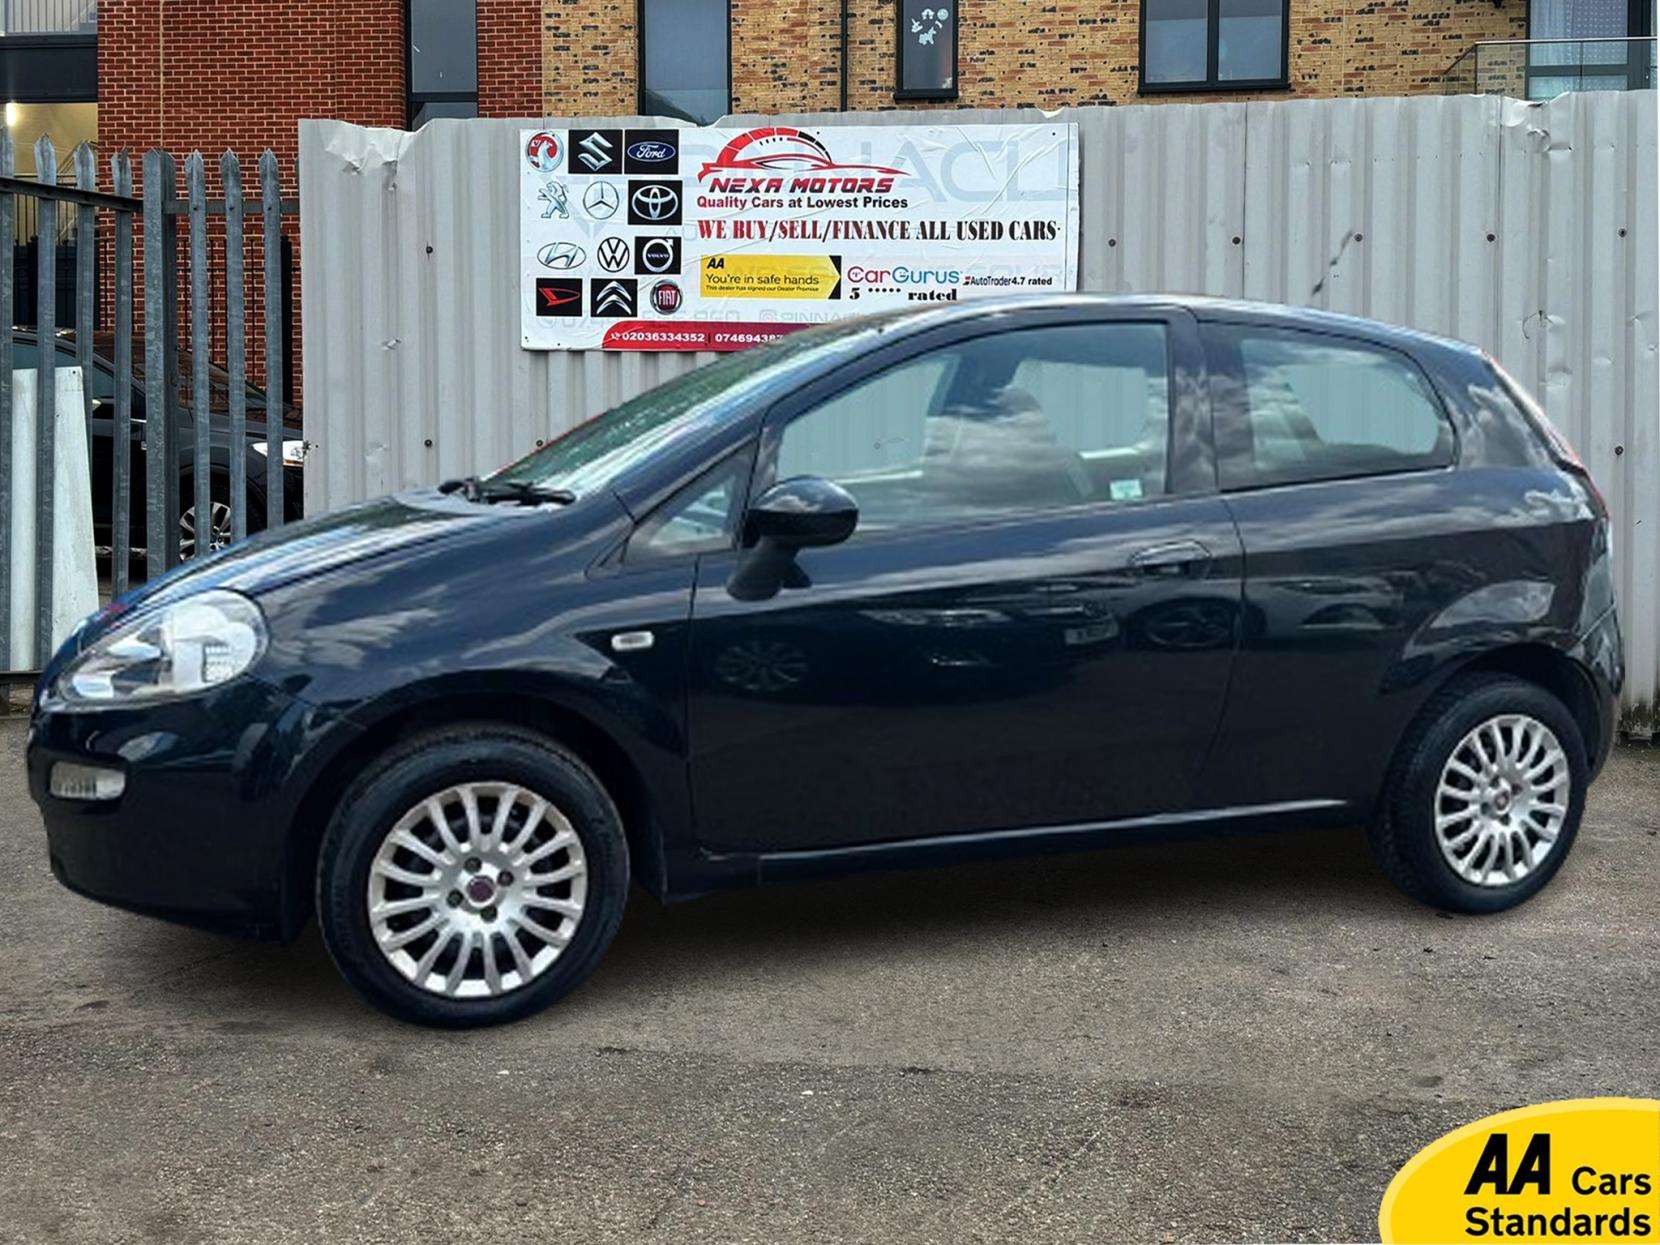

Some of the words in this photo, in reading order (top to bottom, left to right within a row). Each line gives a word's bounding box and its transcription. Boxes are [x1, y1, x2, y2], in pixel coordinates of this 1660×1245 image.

[636, 144, 667, 159] Ford
[709, 177, 784, 194] NEXA
[789, 177, 894, 194] MOTORS
[697, 196, 747, 210] Quality
[752, 196, 783, 208] Cars
[788, 197, 803, 208] at
[807, 196, 858, 208] Lowest
[863, 196, 908, 208] Prices
[697, 220, 727, 240] WE
[733, 220, 910, 242] BUY/SELL/FINANCE
[916, 220, 951, 240] ALL
[956, 220, 1004, 240] USED
[1008, 220, 1057, 240] CARS
[707, 257, 725, 270] AA
[706, 273, 741, 284] You're
[744, 274, 754, 284] in
[757, 274, 781, 285] safe
[784, 274, 820, 285] hands
[847, 266, 960, 284] CarGurus
[1028, 276, 1053, 286] rated
[658, 290, 676, 305] FIAT
[849, 287, 860, 300] 5
[908, 288, 957, 300] rated
[622, 332, 705, 343] 02036334352
